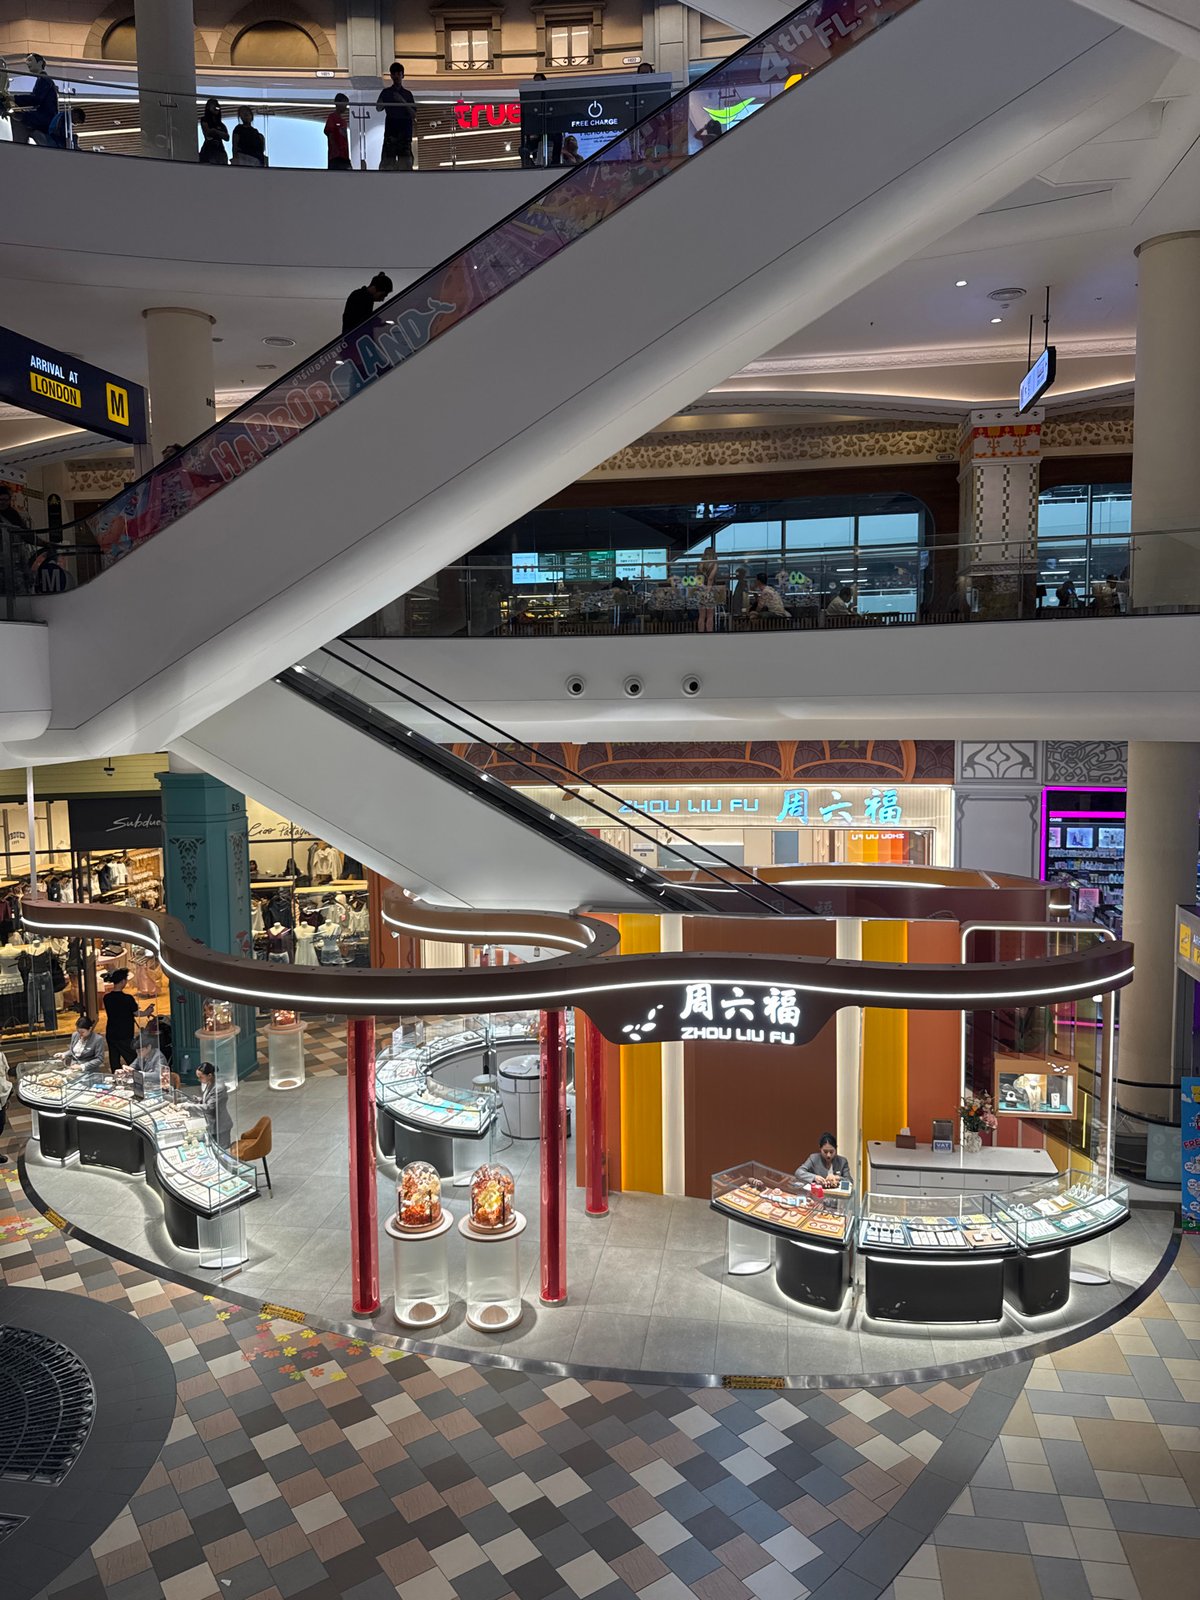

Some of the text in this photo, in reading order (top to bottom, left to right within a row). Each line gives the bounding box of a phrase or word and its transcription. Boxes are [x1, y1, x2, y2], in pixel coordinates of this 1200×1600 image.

[590, 118, 618, 126] CHARGE
[30, 355, 79, 384] ARRIVAL AT
[35, 375, 77, 405] LONDON
[110, 389, 125, 418] M
[618, 798, 759, 813] ZHOU LIU FU
[776, 788, 902, 825] 周六福
[680, 983, 800, 1027] 周六福
[681, 1027, 795, 1045] ZHOU LIU FU
